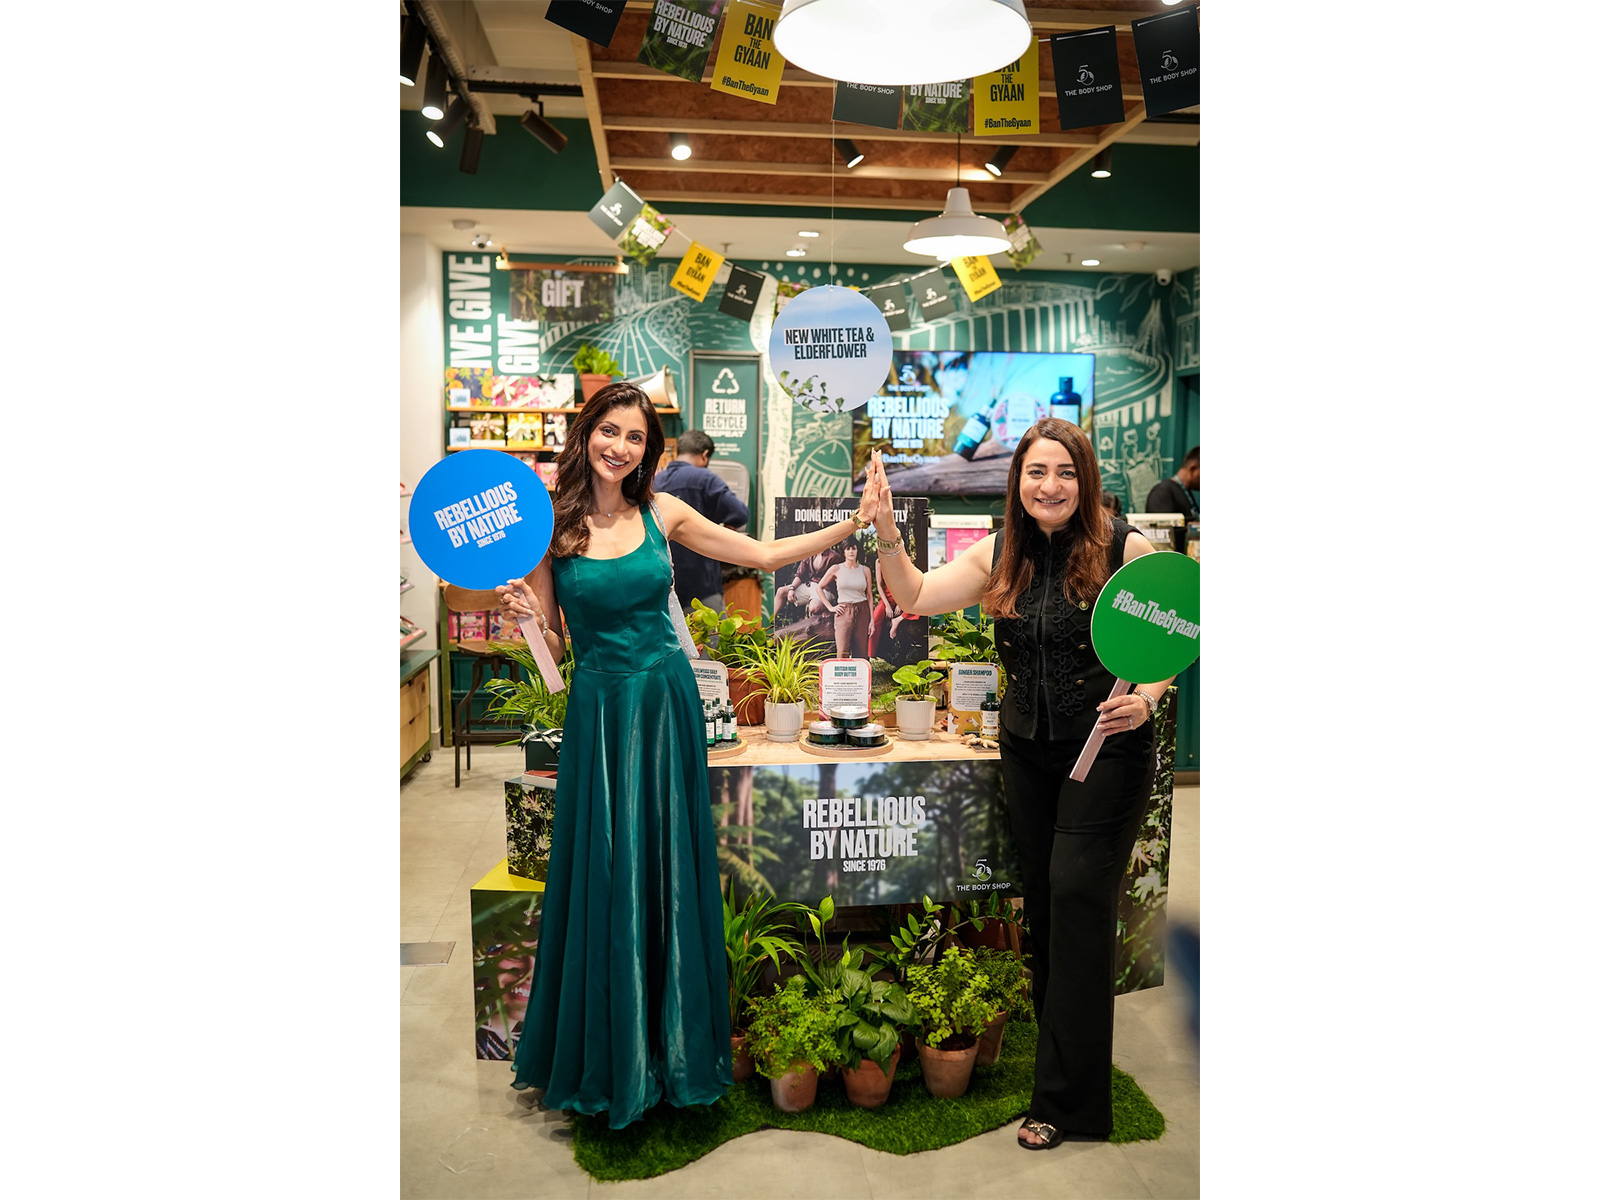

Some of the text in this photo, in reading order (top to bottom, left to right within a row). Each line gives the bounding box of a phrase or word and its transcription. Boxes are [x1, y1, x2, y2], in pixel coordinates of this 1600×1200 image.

[595, 4, 613, 15] SHOP
[655, 0, 715, 34] REBELLIOUS
[653, 16, 708, 48] BY NATURE
[744, 13, 774, 41] BAN
[666, 36, 678, 46] SINCE
[749, 37, 761, 50] THE
[734, 45, 771, 70] GYAAN
[993, 58, 1021, 74] AN
[1001, 74, 1013, 84] THE
[1149, 67, 1198, 85] THE BODY SHOP
[721, 75, 769, 97] #BanTheGyaan
[845, 82, 895, 95] THE BODY SHOP
[910, 83, 962, 99] BY NATURE
[990, 83, 1025, 102] GYAAN
[1078, 86, 1095, 96] BODY
[1095, 84, 1113, 93] SHOP
[984, 117, 1032, 129] #BanTheGyaan
[695, 252, 712, 269] BAN
[541, 278, 585, 309] GIFT
[448, 254, 492, 368] IVE GIVE
[497, 313, 540, 374] GIVE
[785, 327, 875, 345] NEW WHITE TEA &
[794, 343, 867, 360] ELDERFLOWER
[705, 398, 746, 414] RETURN
[867, 396, 950, 418] REBELLIOUS
[705, 415, 744, 429] RECYCLE
[872, 418, 944, 439] BY NATURE
[433, 481, 518, 531] REBELLIOUS
[794, 509, 821, 522] DOING
[447, 502, 523, 549] BY NATURE
[476, 535, 494, 548] SINCE
[1111, 589, 1200, 640] #BanTheGyaan
[972, 669, 993, 677] SHAMPOO
[802, 795, 926, 829] REBELLIOUS
[810, 827, 918, 860] BY NATURE
[842, 859, 886, 873] SINCE 1976
[956, 882, 1011, 892] THE BODY SHOP
